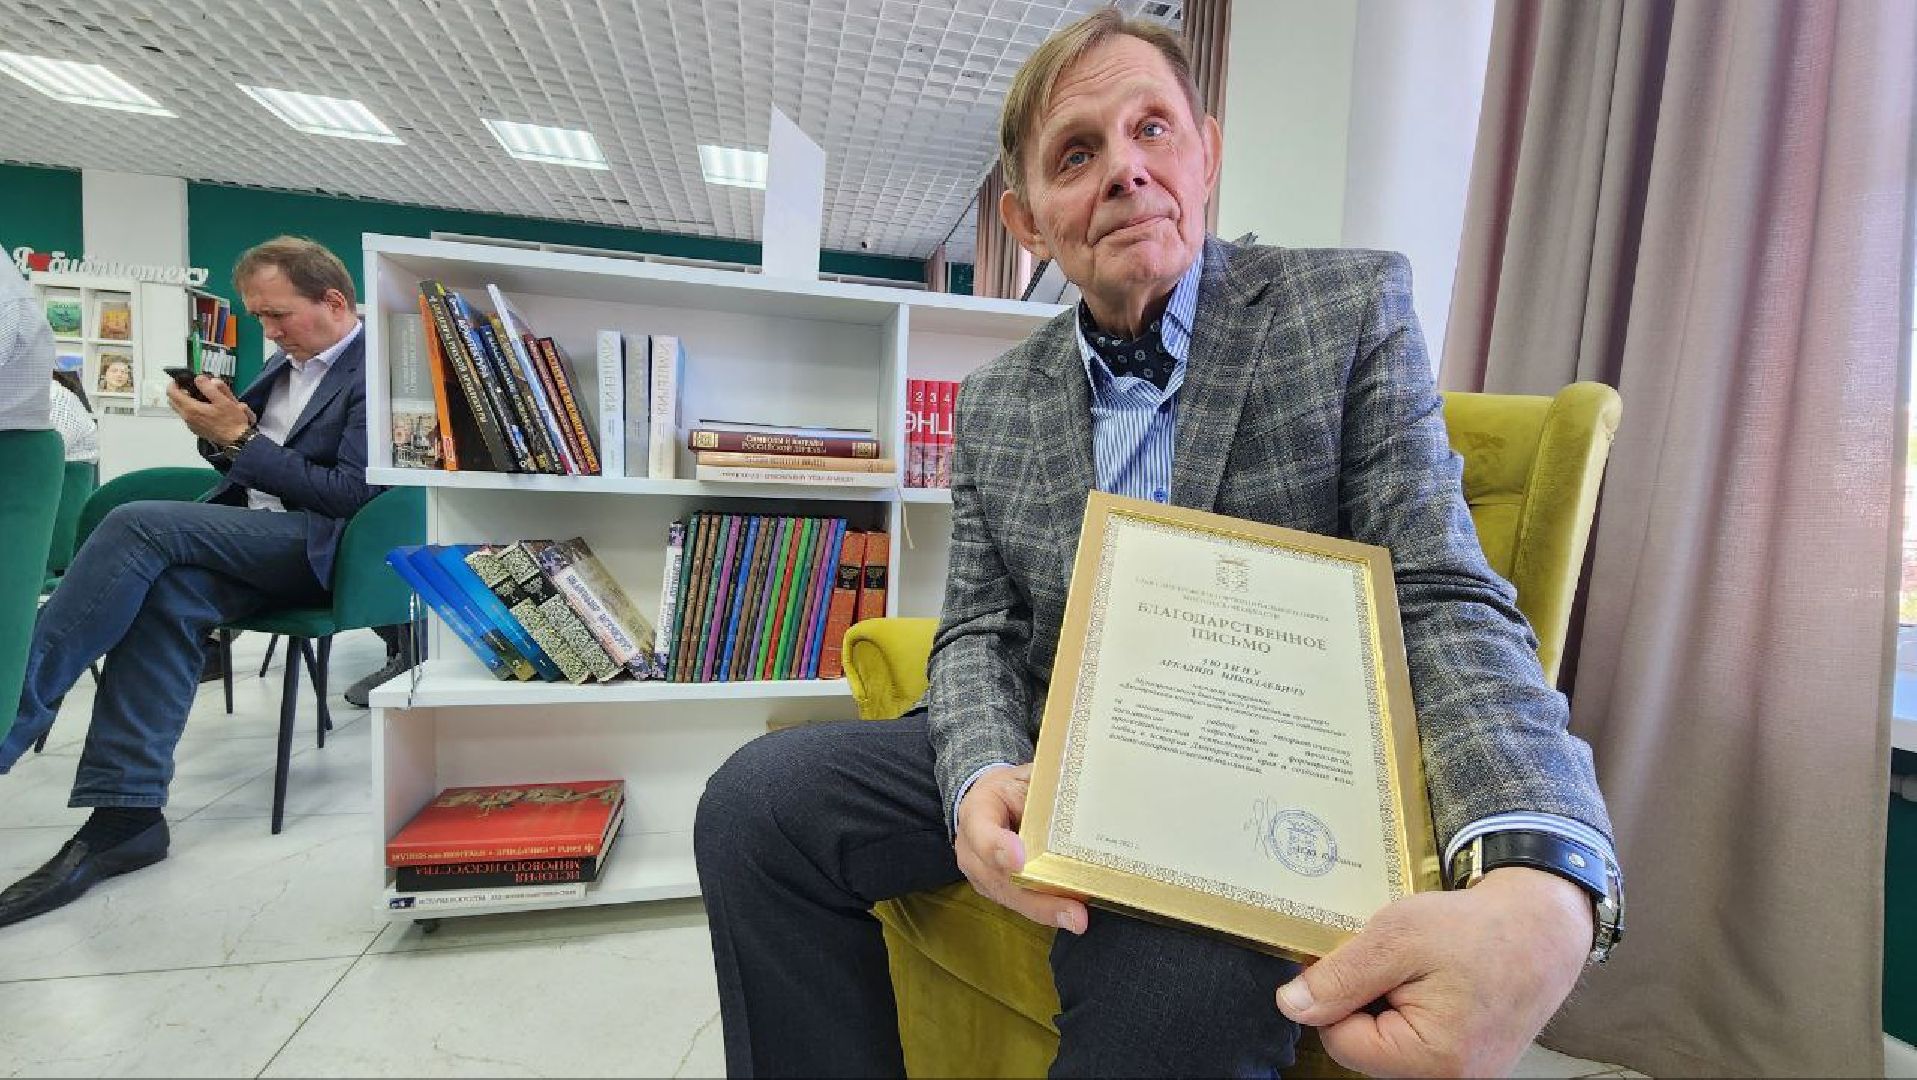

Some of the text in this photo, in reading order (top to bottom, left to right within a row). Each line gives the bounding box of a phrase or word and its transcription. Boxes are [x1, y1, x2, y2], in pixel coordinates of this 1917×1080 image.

[916, 391, 923, 402] 2
[930, 392, 937, 403] 3
[944, 393, 951, 402] 4
[1137, 601, 1328, 651] БЛАГОДАРСТВЕННОЕ
[1191, 626, 1272, 654] ПИСЬМО
[1161, 659, 1306, 697] АРКАДИЮ НИКОЛАЕВИЧУ
[415, 859, 581, 875] МИРОВОГО ИСКУССТВА
[515, 870, 581, 883] ИСТОРИЯ
